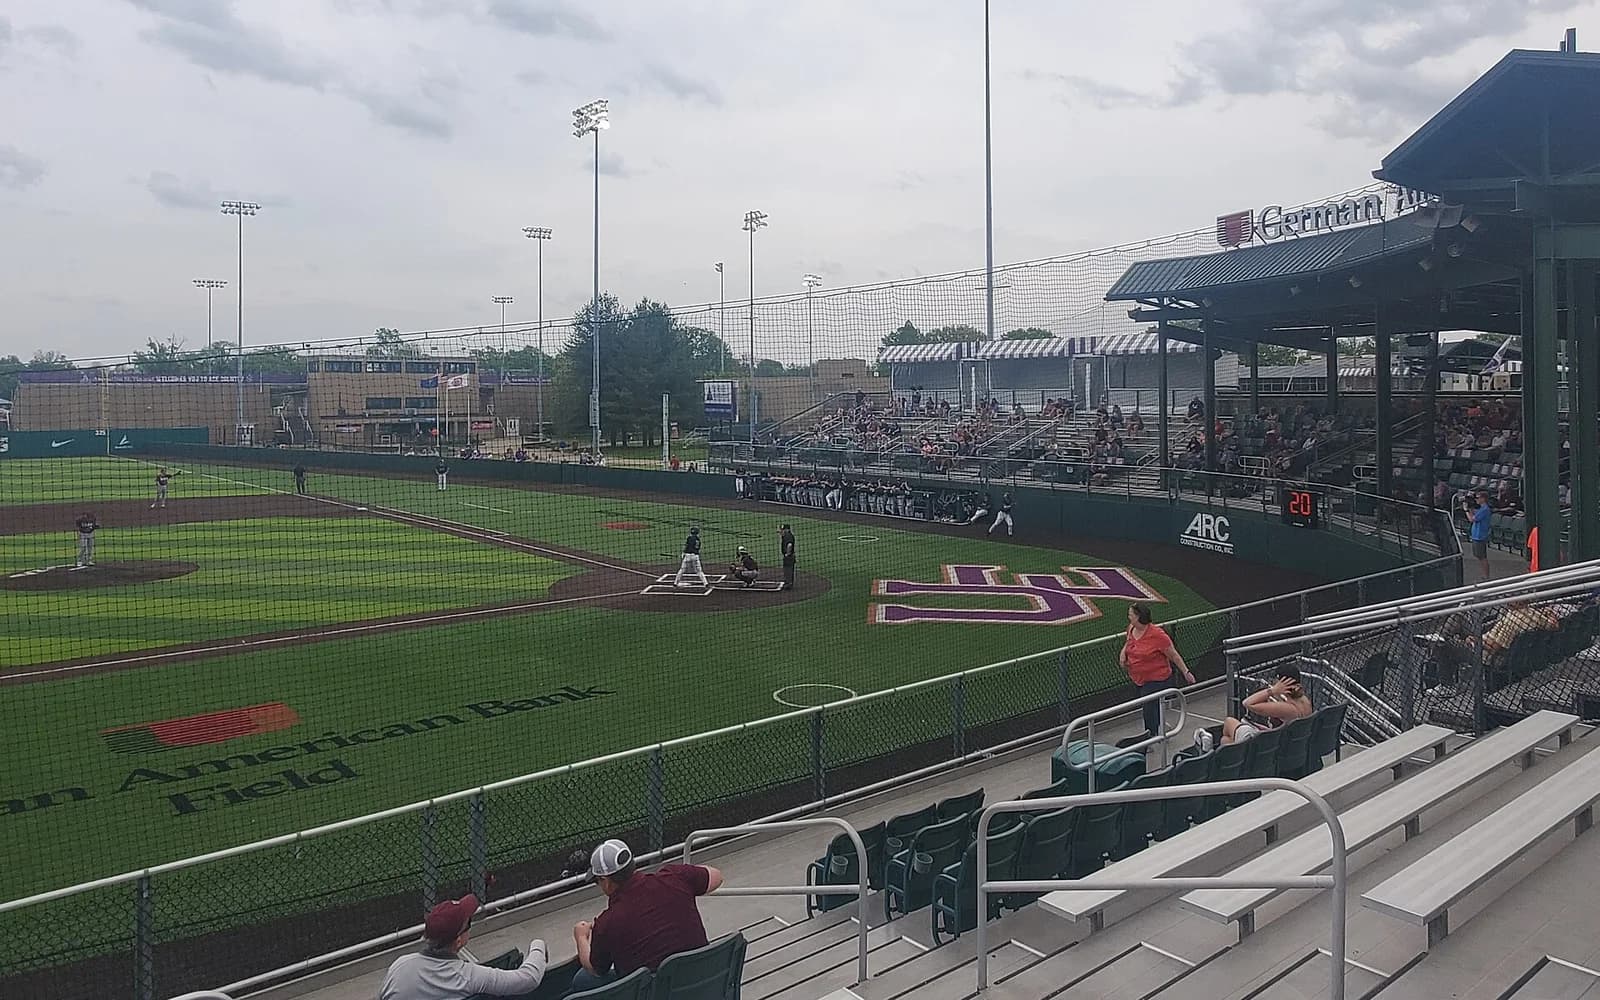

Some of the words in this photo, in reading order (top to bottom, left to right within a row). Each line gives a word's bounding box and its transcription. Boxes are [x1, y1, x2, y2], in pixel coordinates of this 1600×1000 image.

[1257, 193, 1383, 239] German
[1184, 512, 1230, 541] ARC
[1289, 491, 1311, 516] 20
[112, 713, 464, 795] American
[464, 685, 616, 719] Bank
[160, 758, 362, 817] Field
